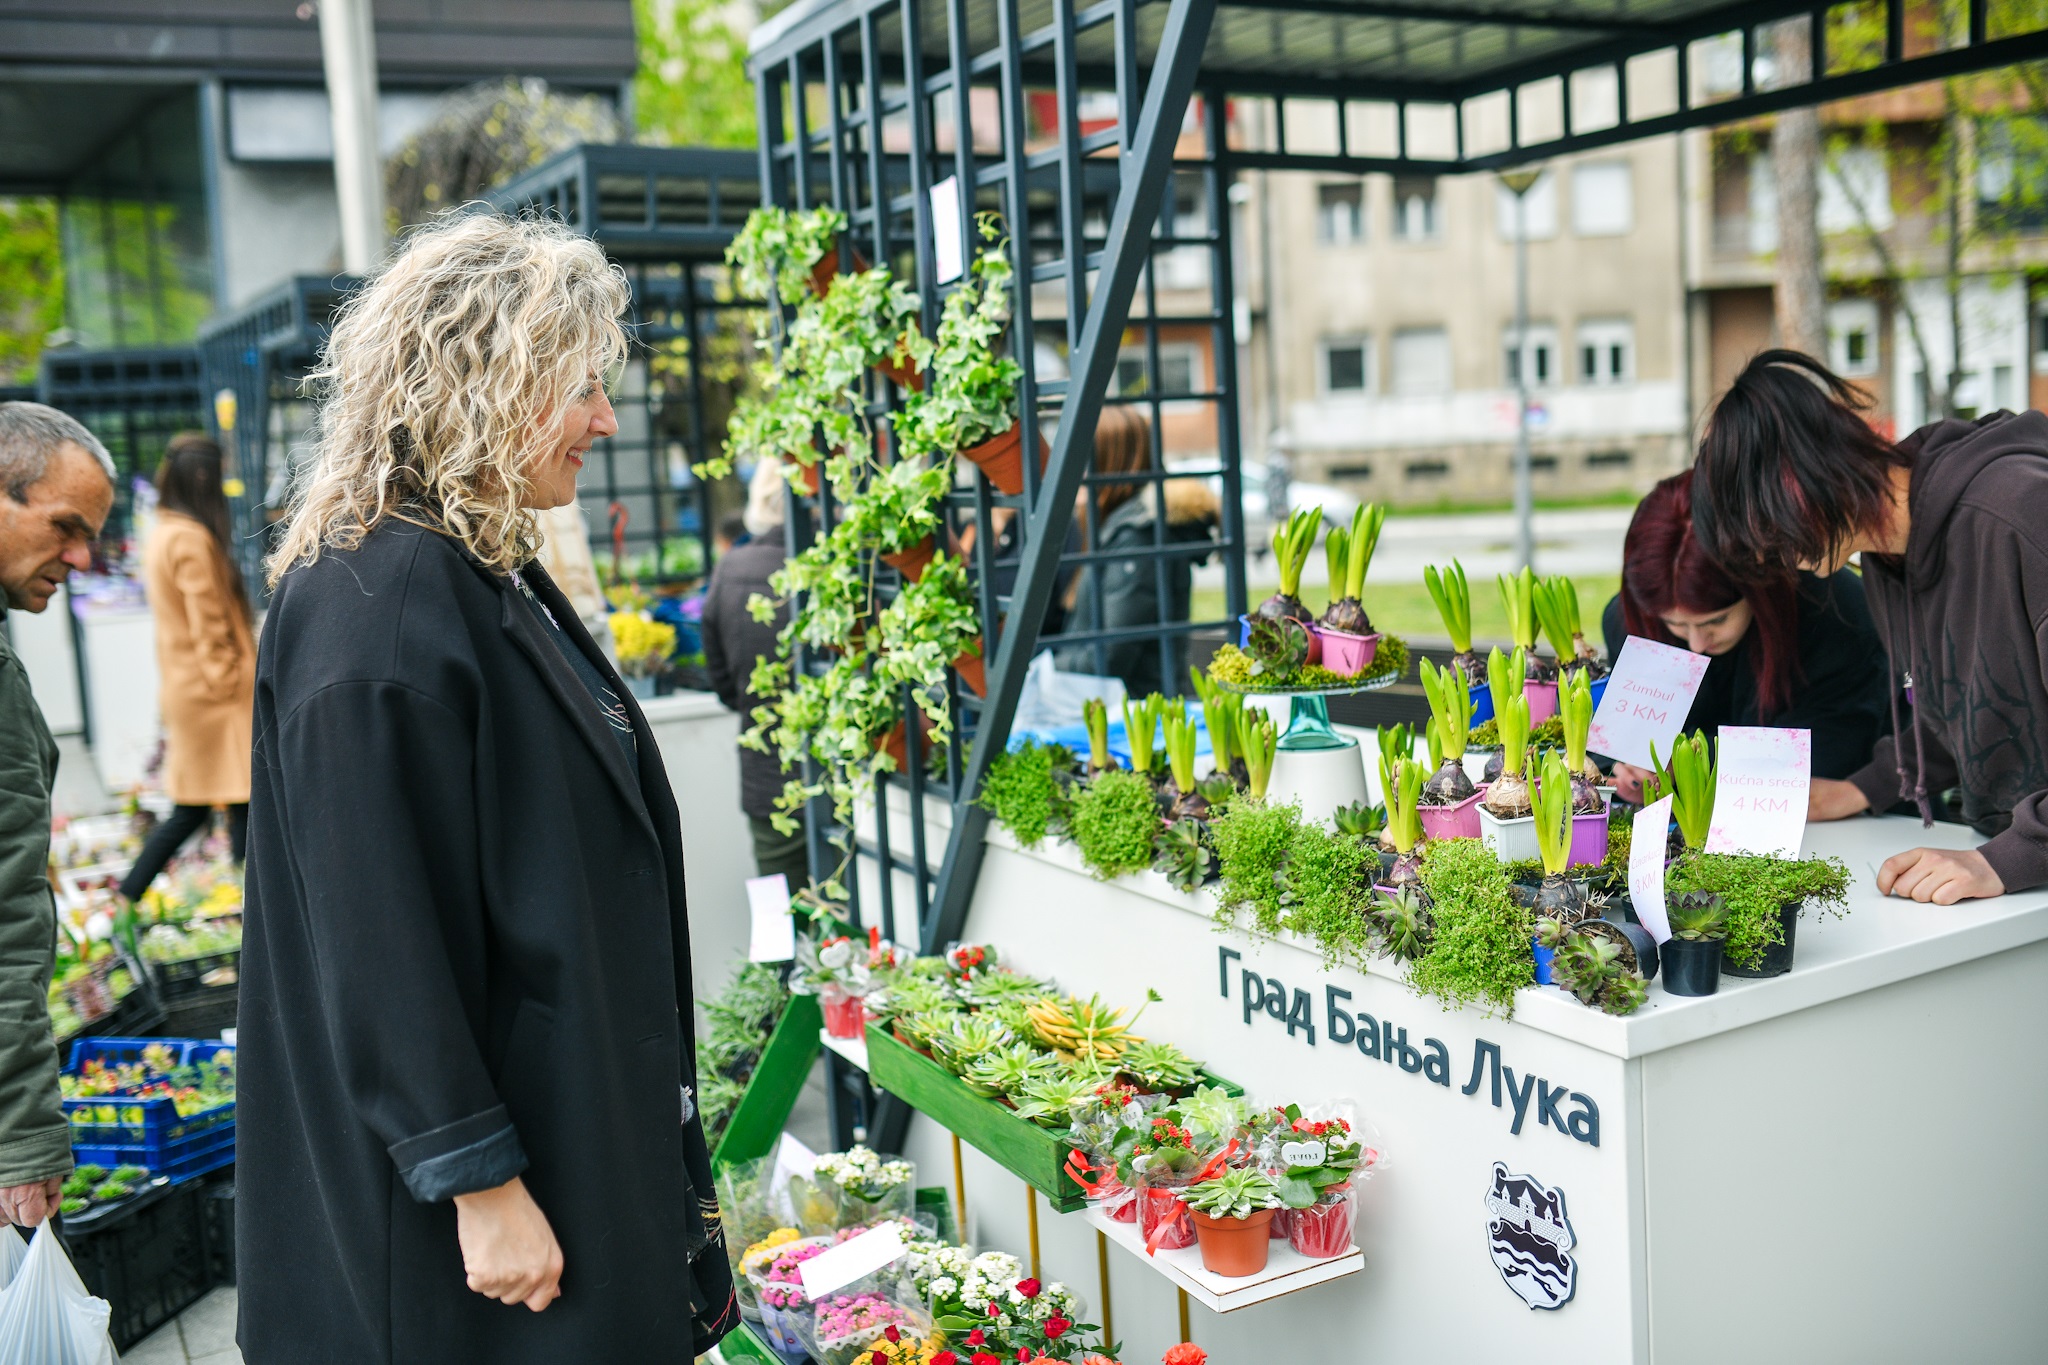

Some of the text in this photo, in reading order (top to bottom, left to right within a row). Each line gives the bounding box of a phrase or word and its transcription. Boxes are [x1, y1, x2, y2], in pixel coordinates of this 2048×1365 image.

[1622, 679, 1675, 702] Zumbul
[1615, 699, 1667, 725] 3 KM
[1719, 773, 1807, 788] Kućna sreća
[1733, 796, 1789, 813] 4 KM
[1635, 869, 1656, 895] 3 KM
[1219, 946, 1600, 1148] Град Бања Лука
